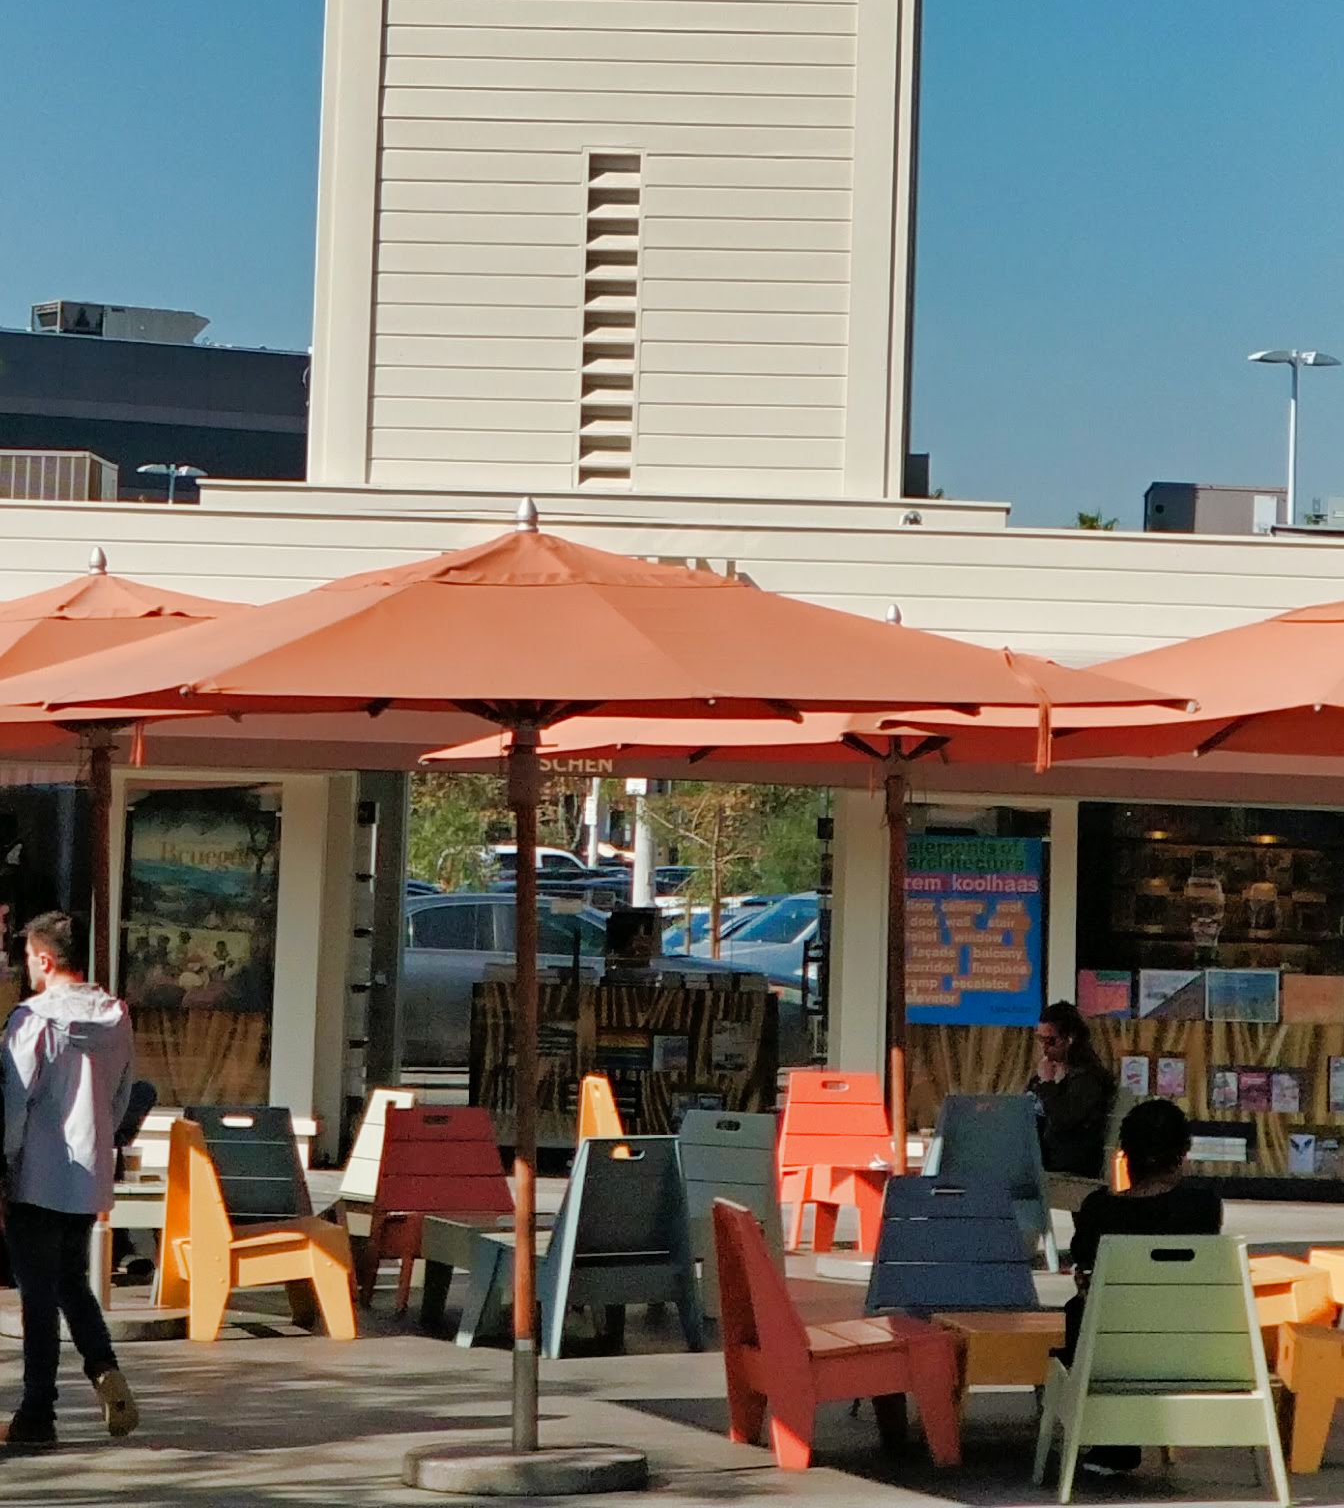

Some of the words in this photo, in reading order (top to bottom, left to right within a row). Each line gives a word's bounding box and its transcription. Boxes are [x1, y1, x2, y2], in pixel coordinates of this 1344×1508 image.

[539, 758, 613, 773] SCHEN
[904, 877, 942, 891] rem
[951, 873, 1039, 892] koolhaas
[955, 931, 1003, 942] window
[972, 946, 1023, 960] balcony
[905, 962, 956, 973] corridor
